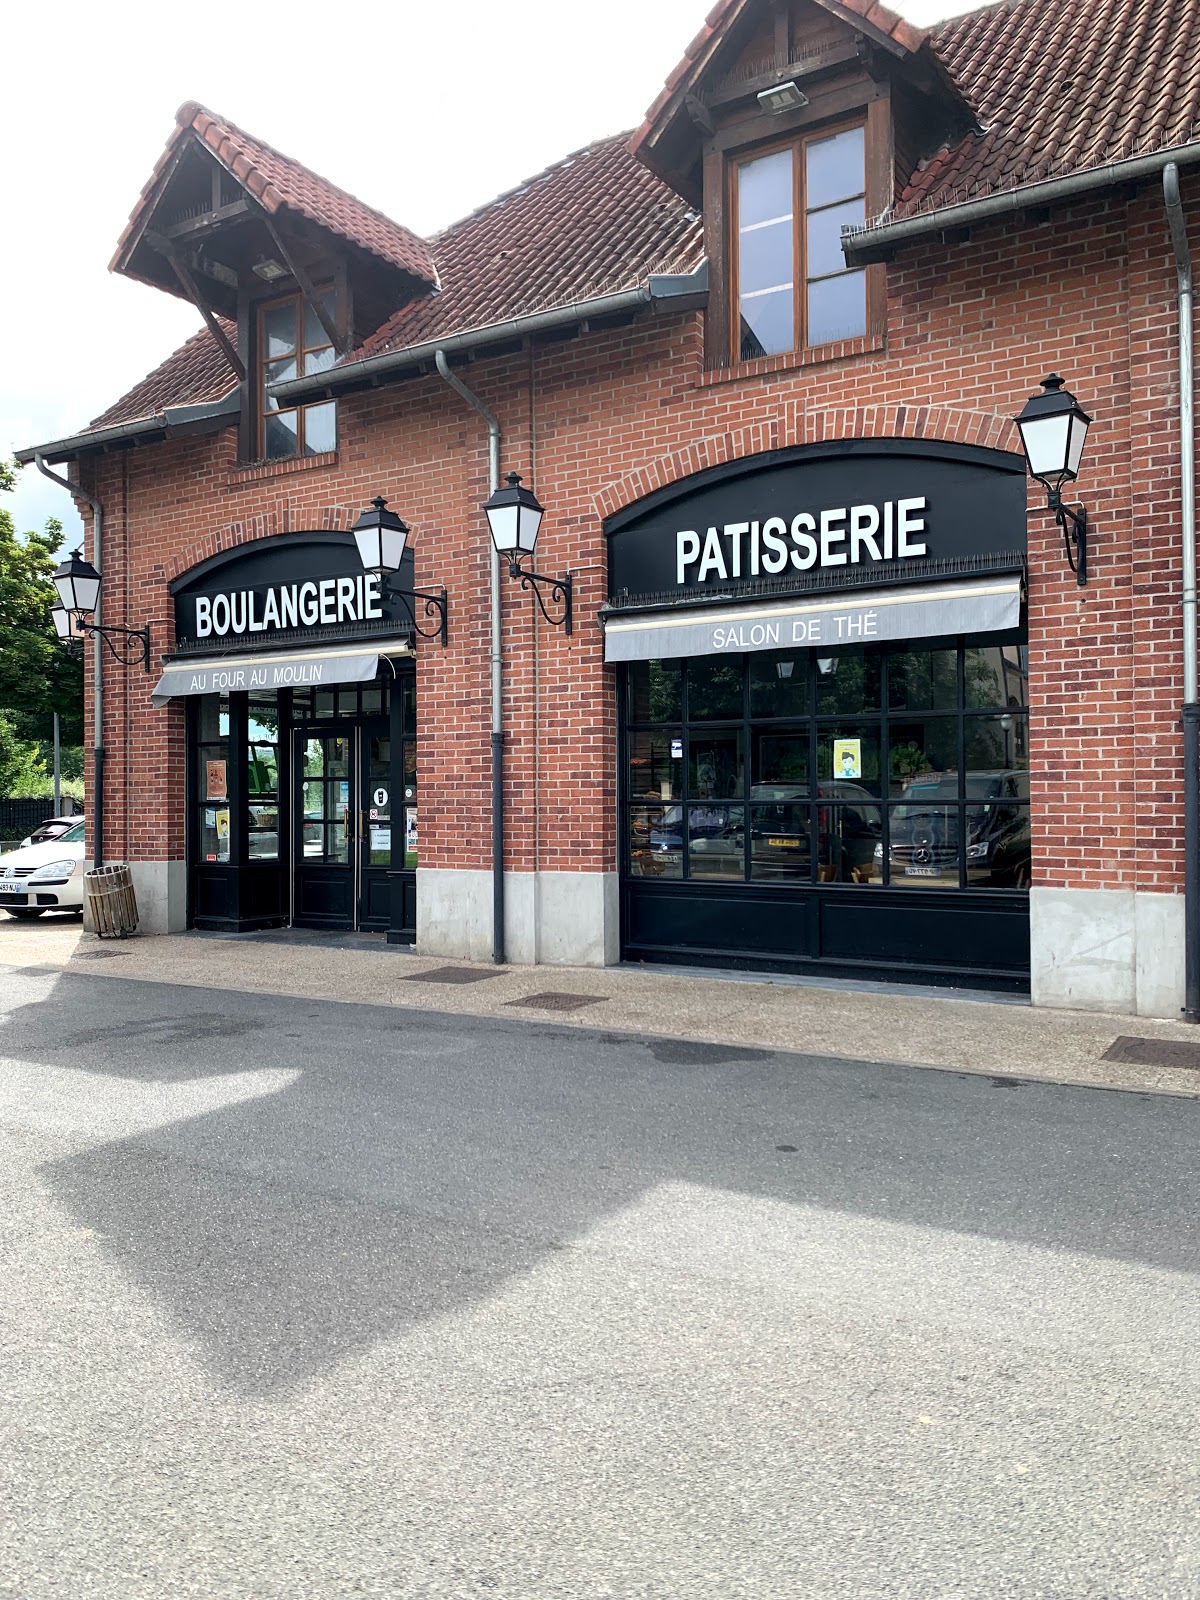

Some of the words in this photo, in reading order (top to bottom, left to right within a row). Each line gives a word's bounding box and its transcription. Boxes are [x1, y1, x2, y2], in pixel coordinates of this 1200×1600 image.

[676, 496, 926, 584] PATISSERIE
[195, 574, 382, 638] BOULANGERIE
[712, 623, 780, 648] SALON
[792, 620, 821, 642] DE
[833, 610, 877, 638] THÉ
[190, 674, 206, 691] AU
[212, 670, 245, 688] FOUR
[250, 668, 267, 686] AU
[273, 664, 323, 684] MOULIN
